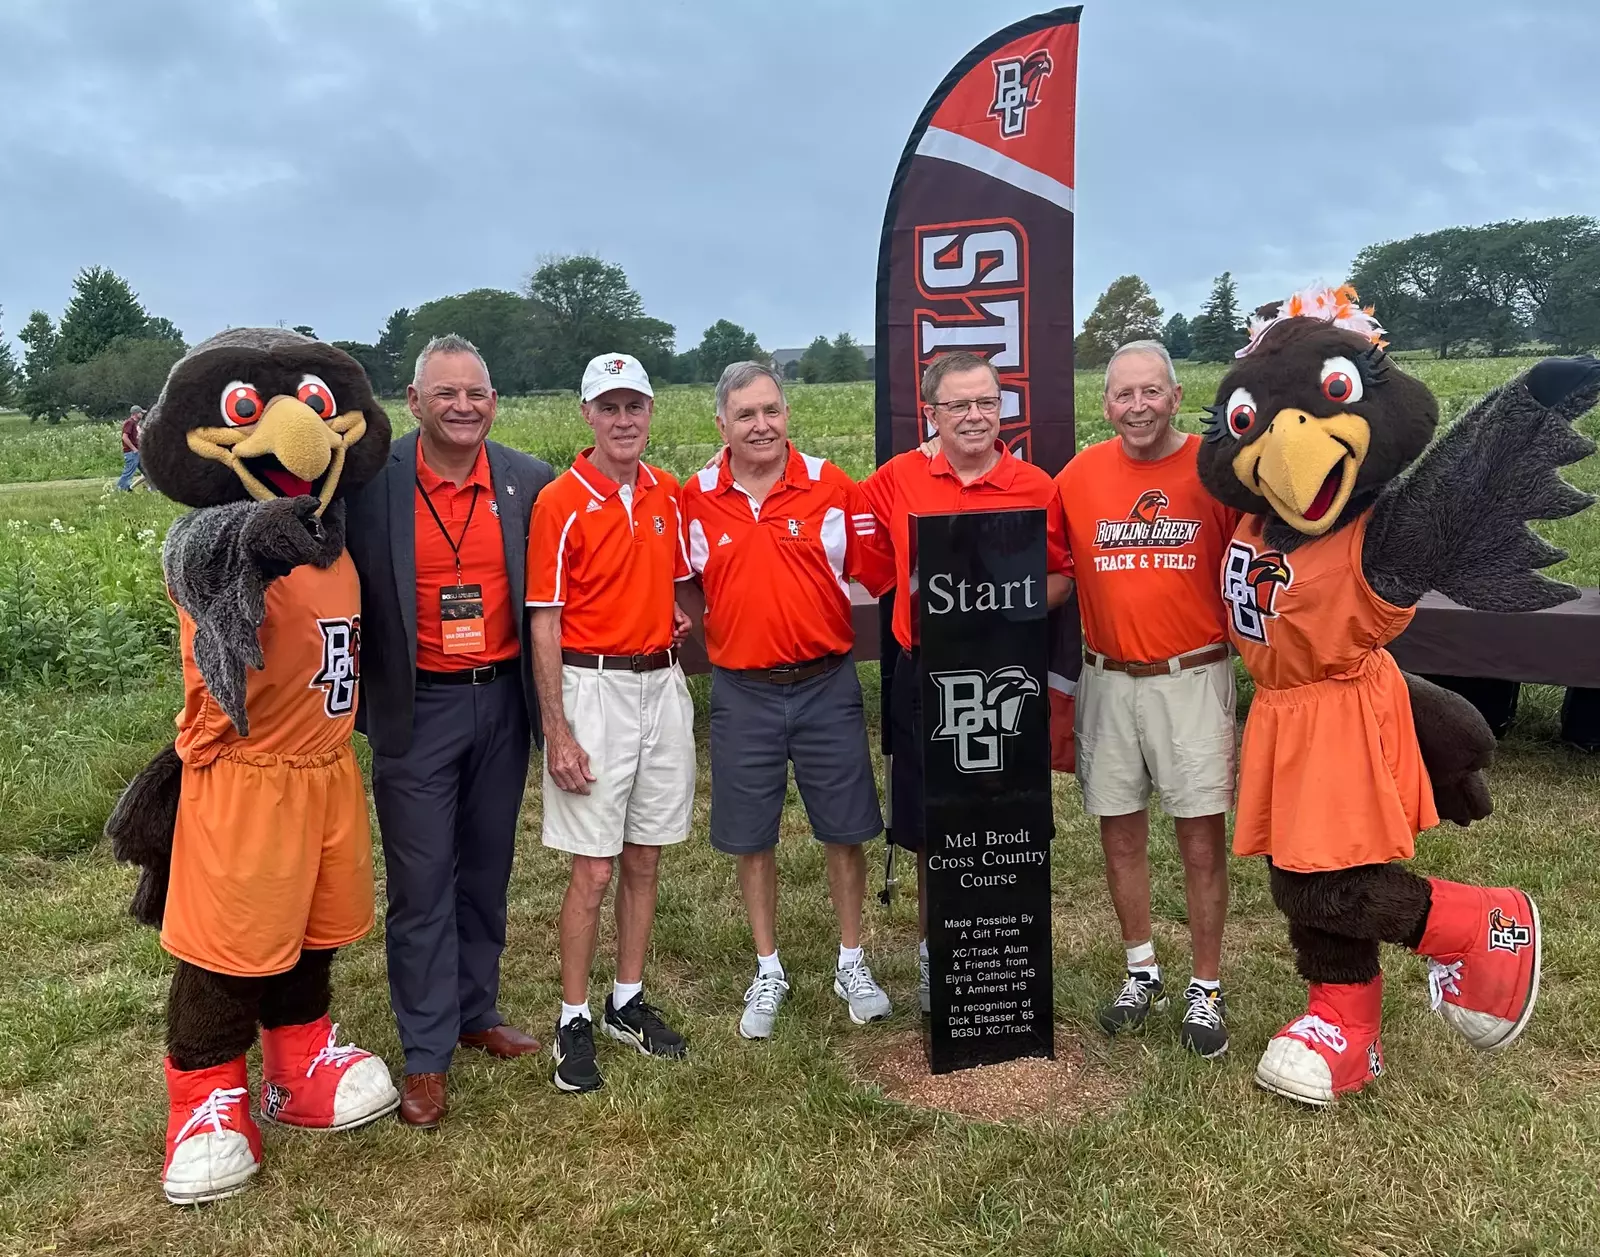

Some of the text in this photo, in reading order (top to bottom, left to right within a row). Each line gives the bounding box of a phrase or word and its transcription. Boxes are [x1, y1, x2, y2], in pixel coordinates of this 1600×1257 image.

[1097, 518, 1197, 543] BOWLING GREEN
[1094, 553, 1196, 572] TRACK & FIELD
[927, 572, 1038, 615] Start
[944, 828, 1031, 849] Mel Brodt
[928, 850, 1048, 871] Cross Country
[960, 873, 1017, 888] Course
[944, 914, 1034, 929] Made Possible By
[960, 928, 1020, 940] A Gift From
[952, 945, 1029, 959] XC/Track Alum
[953, 957, 1028, 971] & Friends from
[945, 968, 1036, 985] Elyria Catholic HS
[954, 981, 1027, 996] & Amherst HS
[950, 998, 1032, 1013] In recognition of
[948, 1010, 1035, 1026] Dick Elsasser '65
[951, 1024, 1032, 1038] BGSU XC/Track
